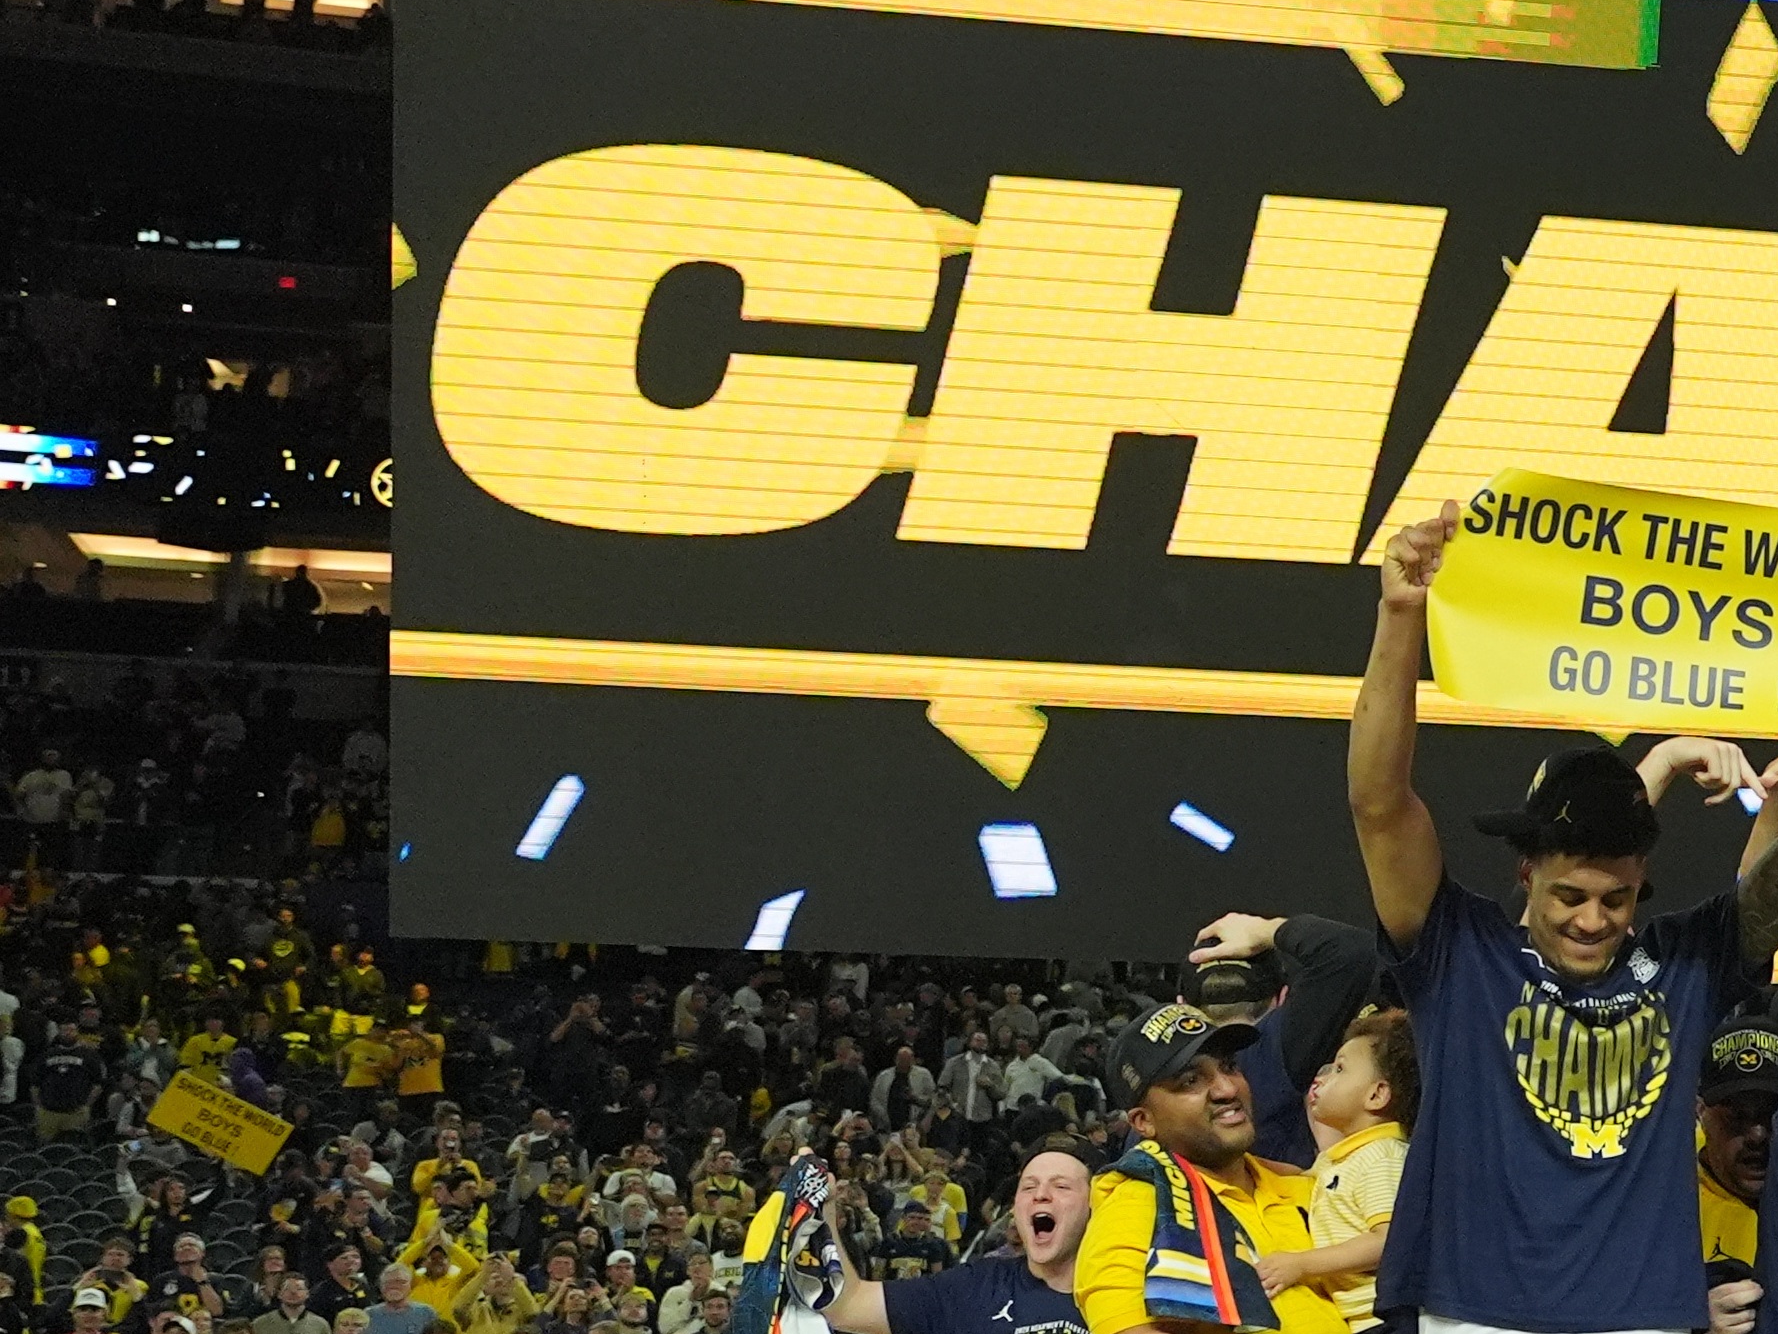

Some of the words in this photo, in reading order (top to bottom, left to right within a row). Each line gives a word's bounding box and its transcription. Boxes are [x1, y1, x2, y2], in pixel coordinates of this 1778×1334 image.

[1464, 488, 1628, 555] SHOCK
[1642, 513, 1729, 571] THE
[1580, 575, 1775, 649] BOYS
[1548, 646, 1611, 695] GO
[1628, 656, 1746, 711] BLUE
[1571, 1122, 1627, 1160] M
